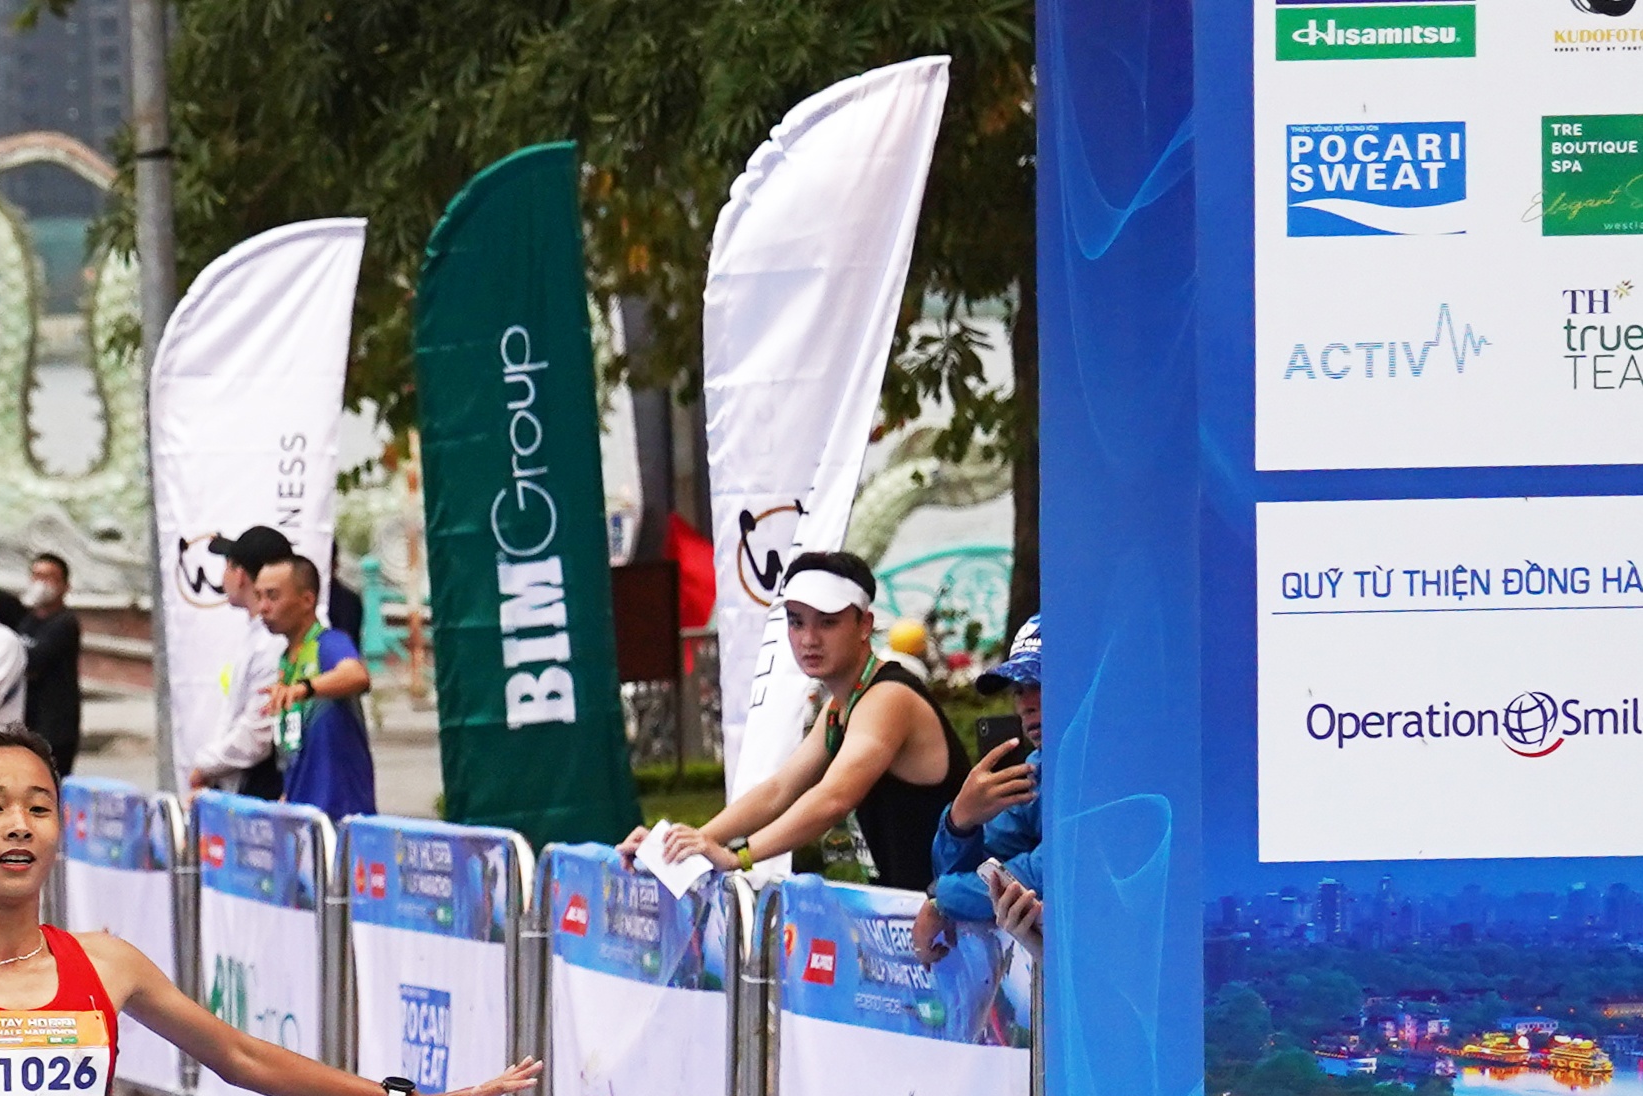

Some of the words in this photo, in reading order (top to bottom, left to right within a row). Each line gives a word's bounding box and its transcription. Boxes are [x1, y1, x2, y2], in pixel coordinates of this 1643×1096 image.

[1292, 19, 1457, 46] Hisamitsu
[1550, 123, 1583, 136] TRE
[1289, 133, 1460, 164] POCARI
[1551, 140, 1639, 154] BOUTIQUE
[1289, 161, 1447, 193] SWEAT
[1551, 160, 1583, 173] SPA
[1562, 288, 1612, 315] TH
[1563, 317, 1643, 352] true
[1282, 341, 1435, 381] ACTIV
[1563, 353, 1643, 390] TEA
[276, 431, 308, 545] NESS
[1281, 567, 1345, 600] QUỸ
[1352, 564, 1393, 598] TỪ
[1403, 562, 1492, 602] THIỆN
[1502, 559, 1592, 597] ĐỒNG
[1306, 700, 1501, 749] Operation
[1562, 698, 1643, 738] Smil
